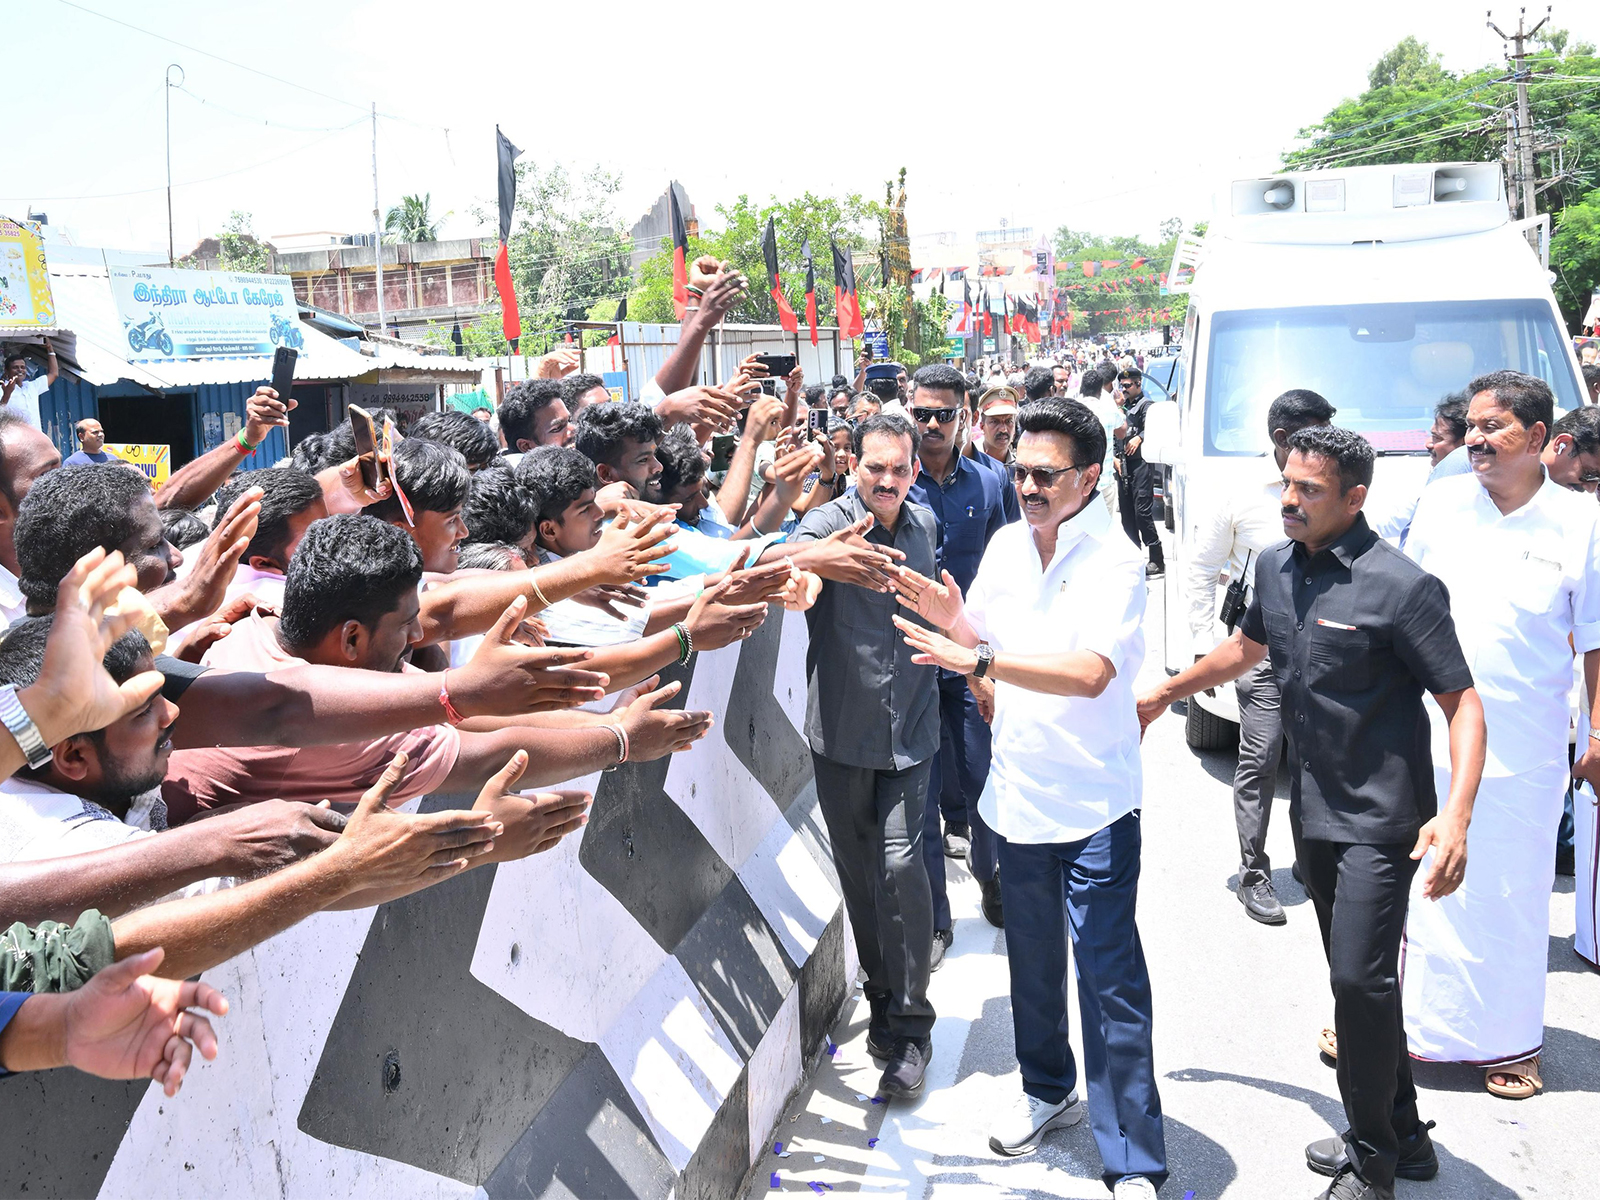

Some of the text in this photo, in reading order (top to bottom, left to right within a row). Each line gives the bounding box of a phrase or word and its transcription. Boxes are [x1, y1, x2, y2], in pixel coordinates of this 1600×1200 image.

[133, 282, 284, 308] இந்திரா ஆட்டோ கேரேஜ்
